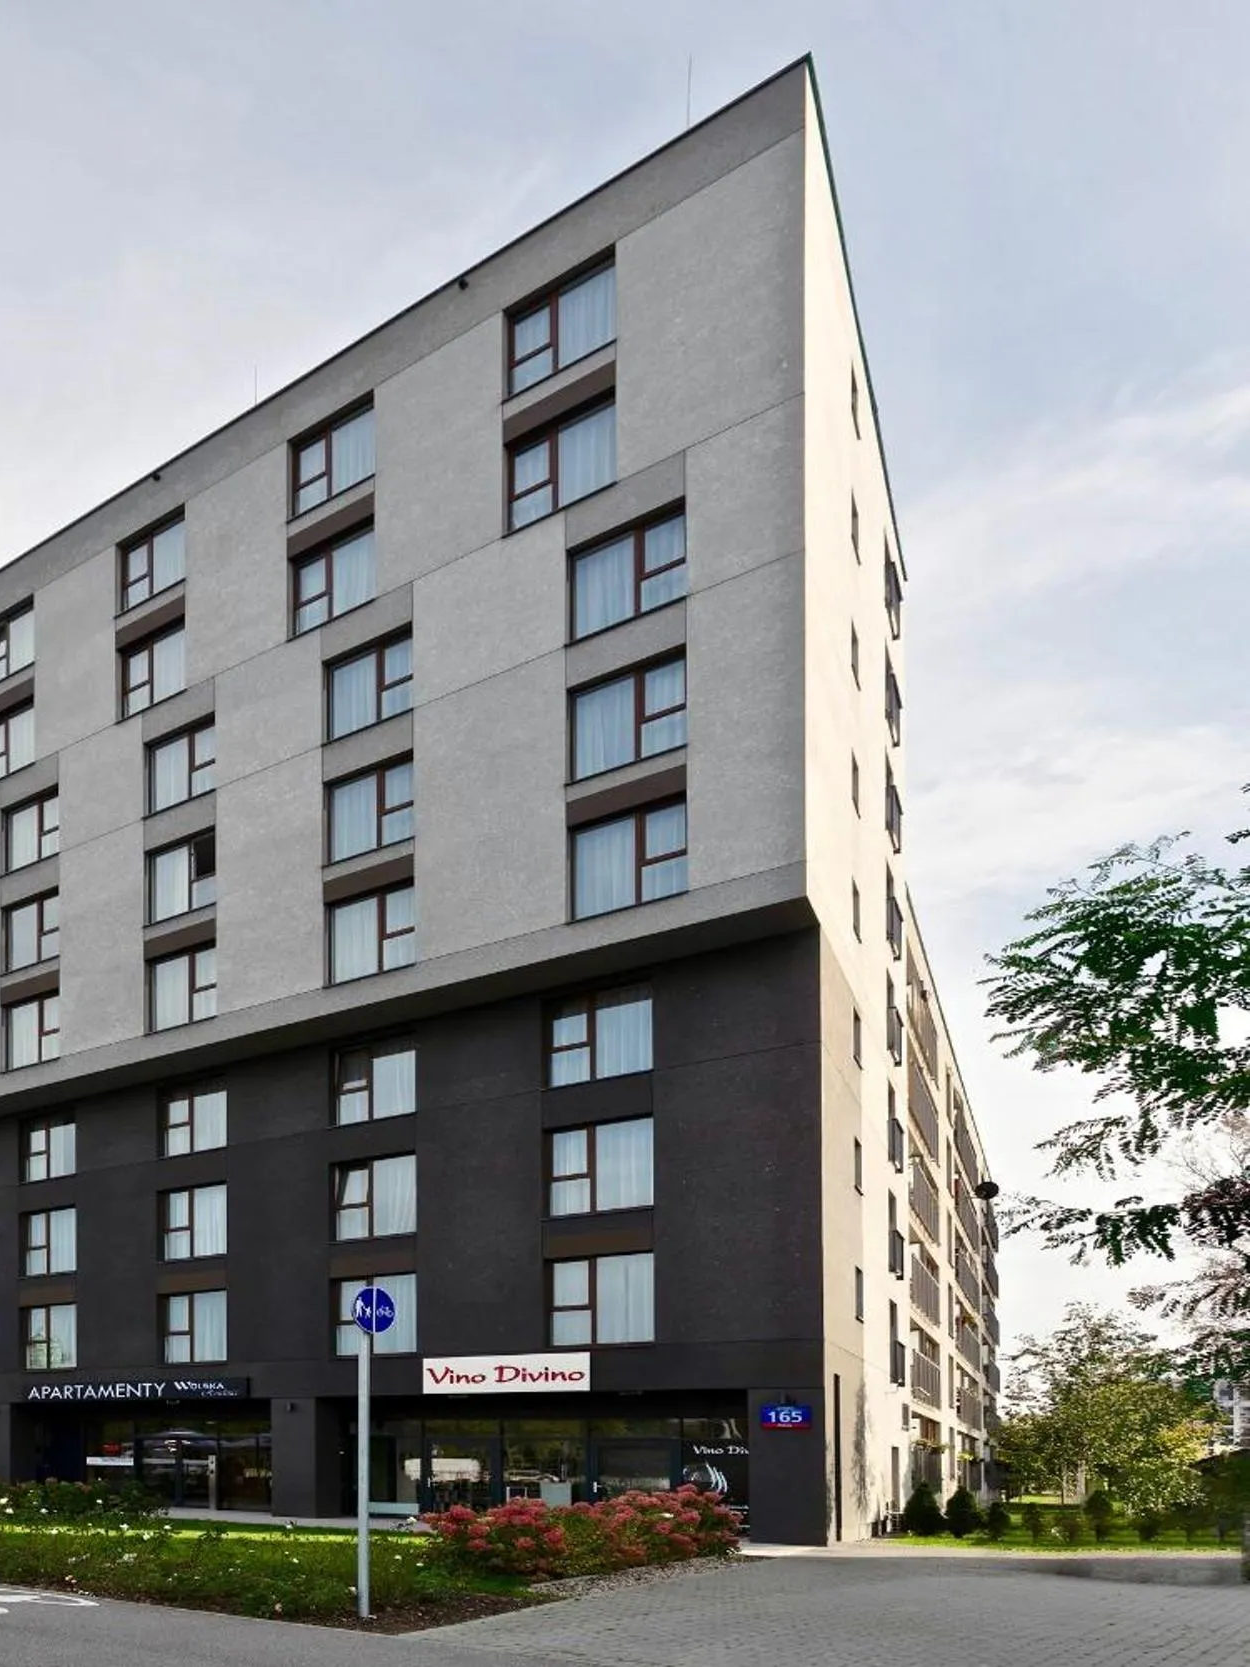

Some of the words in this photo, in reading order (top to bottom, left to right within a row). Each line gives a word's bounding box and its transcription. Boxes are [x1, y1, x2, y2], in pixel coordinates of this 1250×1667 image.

[426, 1366, 486, 1385] Vino
[494, 1364, 585, 1383] Divino
[28, 1382, 166, 1400] APARTAMENTY
[768, 1411, 803, 1423] 165
[693, 1444, 724, 1455] Vino
